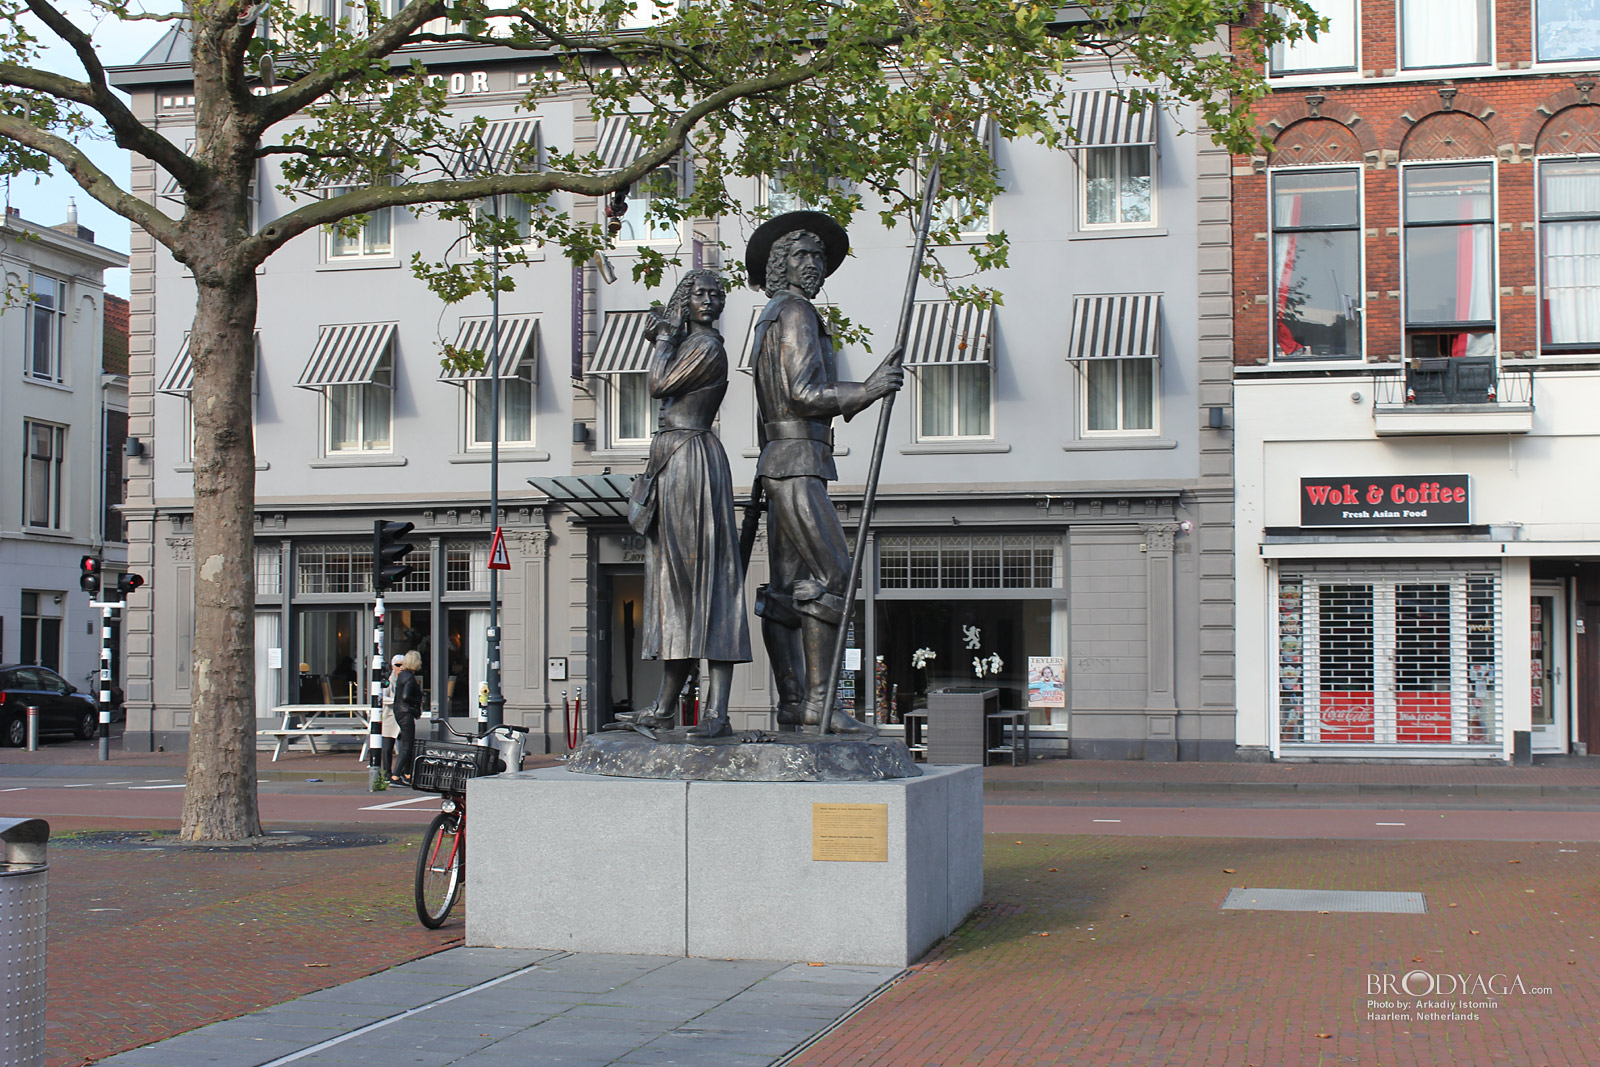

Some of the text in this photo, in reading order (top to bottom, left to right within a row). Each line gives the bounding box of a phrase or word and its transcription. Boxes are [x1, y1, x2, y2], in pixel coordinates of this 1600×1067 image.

[1305, 482, 1466, 505] Wok & Coffee
[1372, 510, 1401, 518] Asian
[1402, 509, 1427, 518] Food
